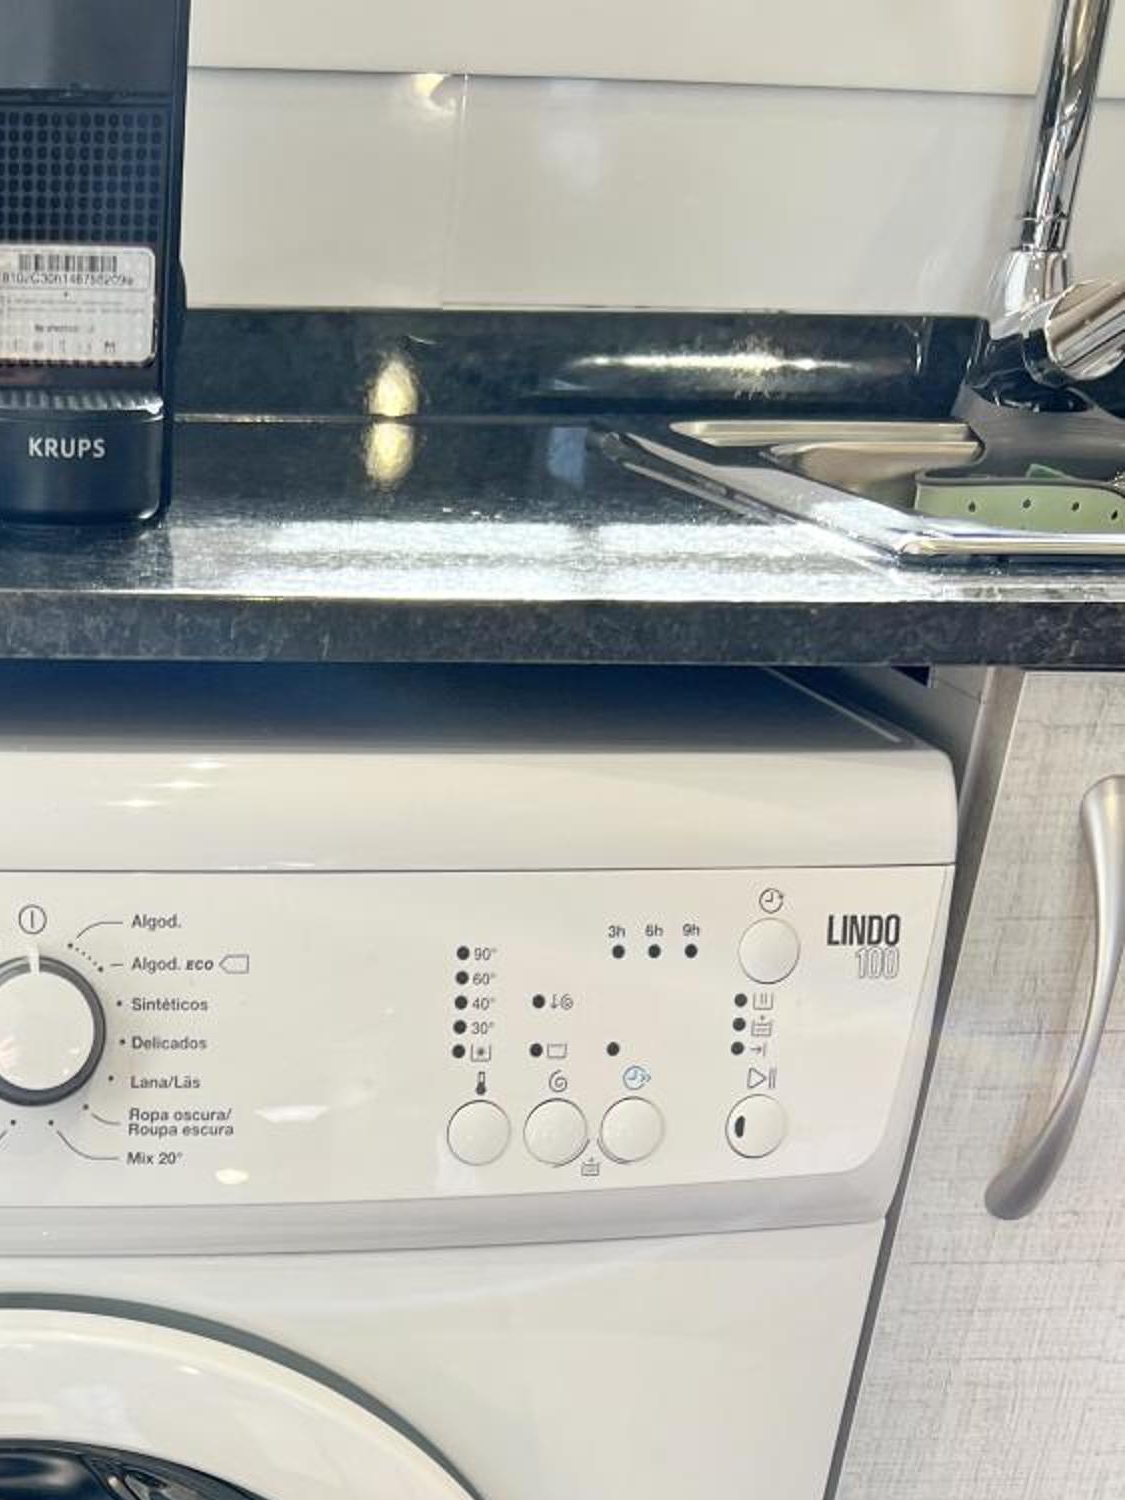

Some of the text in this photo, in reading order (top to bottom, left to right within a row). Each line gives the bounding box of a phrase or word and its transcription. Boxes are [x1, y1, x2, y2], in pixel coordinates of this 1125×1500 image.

[28, 437, 106, 459] KRUPS
[131, 913, 182, 931] Algod.
[608, 925, 626, 938] 3h
[645, 923, 664, 937] 6h
[682, 923, 700, 936] 9h
[827, 914, 901, 946] LINDO
[474, 947, 498, 961] 90°
[131, 957, 214, 974] Algod. ECO
[856, 946, 900, 980] 100
[473, 972, 497, 986] 60°
[131, 997, 208, 1011] Sintéticos
[472, 997, 496, 1011] 40°
[471, 1021, 495, 1035] 30°
[131, 1036, 208, 1050] Delicados
[129, 1107, 232, 1123] Ropa oscura/
[127, 1123, 234, 1140] Roupa escura
[126, 1151, 183, 1165] Mix 20°
